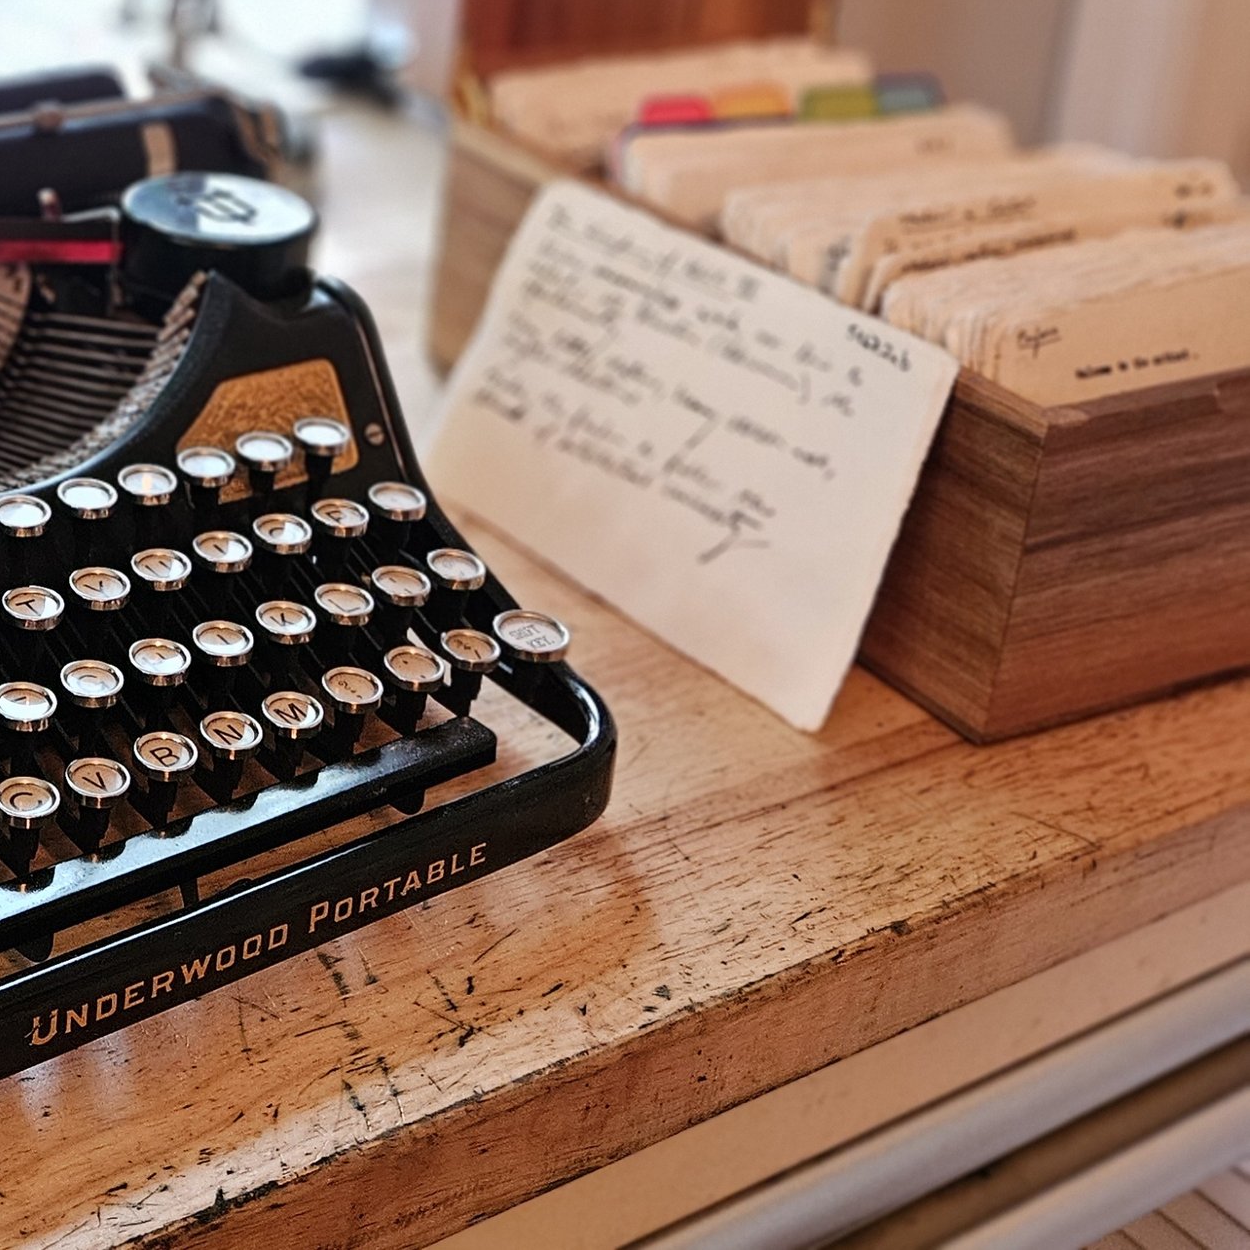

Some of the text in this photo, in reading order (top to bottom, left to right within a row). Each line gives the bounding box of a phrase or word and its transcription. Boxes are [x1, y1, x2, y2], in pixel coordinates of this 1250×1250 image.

[273, 702, 306, 724] M
[213, 724, 242, 745] N
[150, 747, 180, 767] B
[82, 772, 108, 791] V
[10, 792, 43, 811] C
[29, 842, 488, 1047] UNDERWOOD PORTABLE
